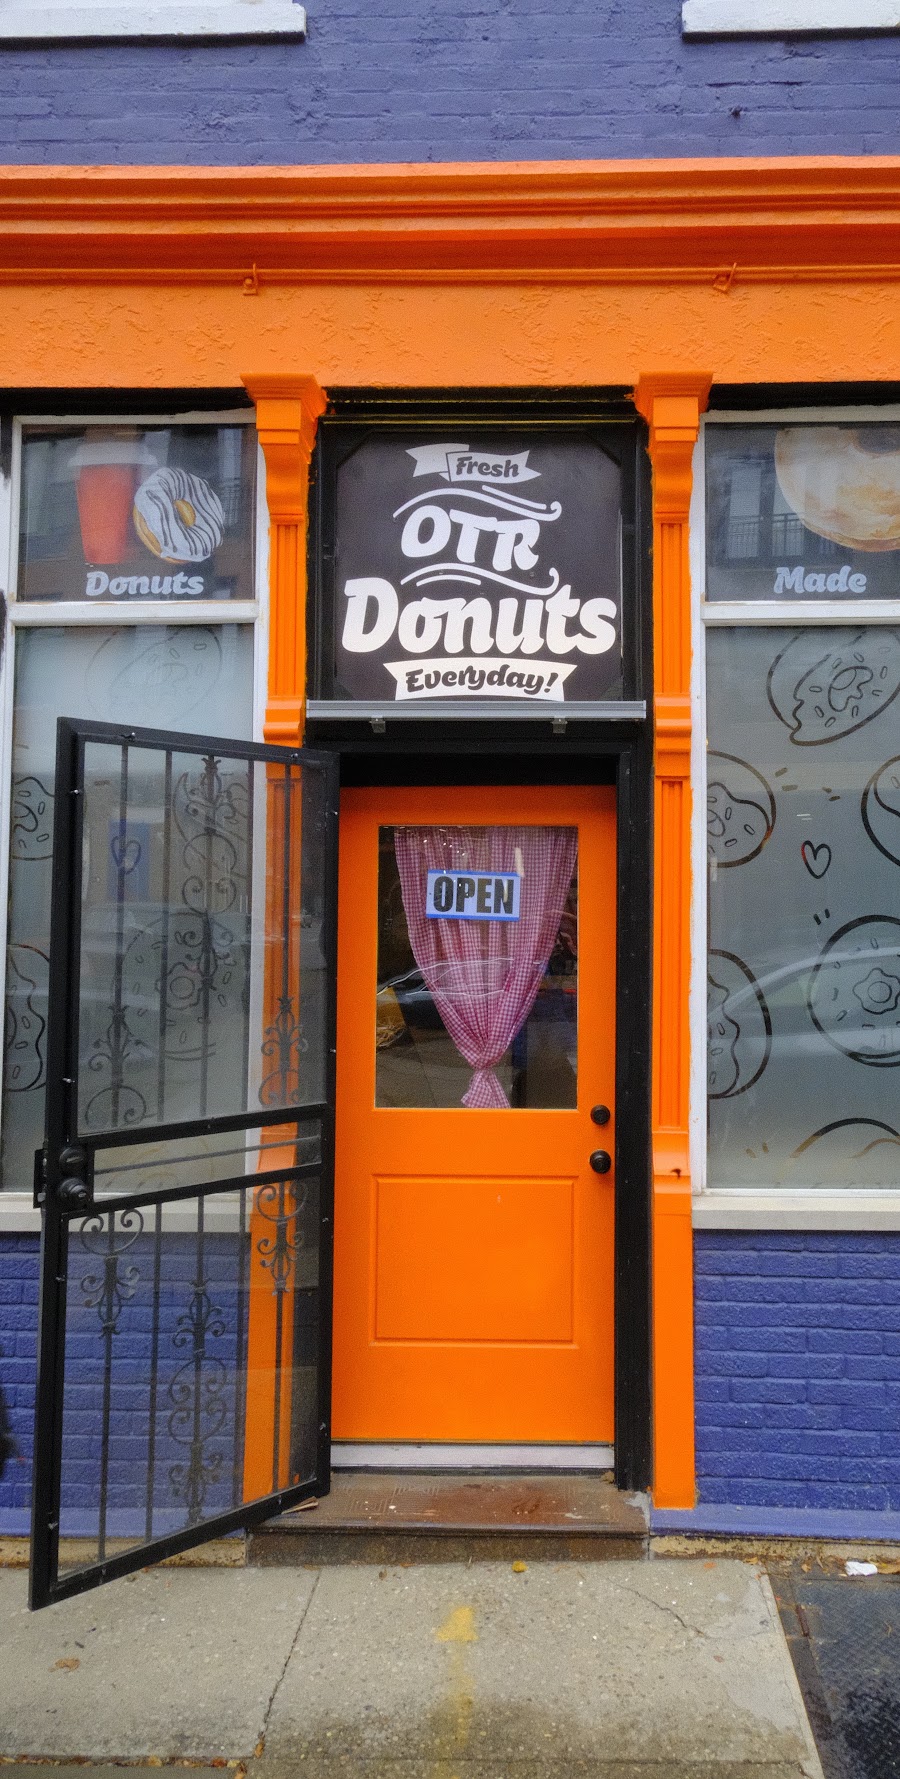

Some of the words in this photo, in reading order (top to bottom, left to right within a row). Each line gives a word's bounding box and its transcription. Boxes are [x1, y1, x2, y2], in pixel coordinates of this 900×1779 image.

[455, 456, 519, 478] Fresh
[401, 505, 540, 571] OTR
[86, 571, 204, 596] Donuts
[773, 565, 867, 594] Made
[341, 577, 617, 655] Donuts
[405, 664, 558, 693] Everyday!
[433, 876, 515, 914] OPEN
